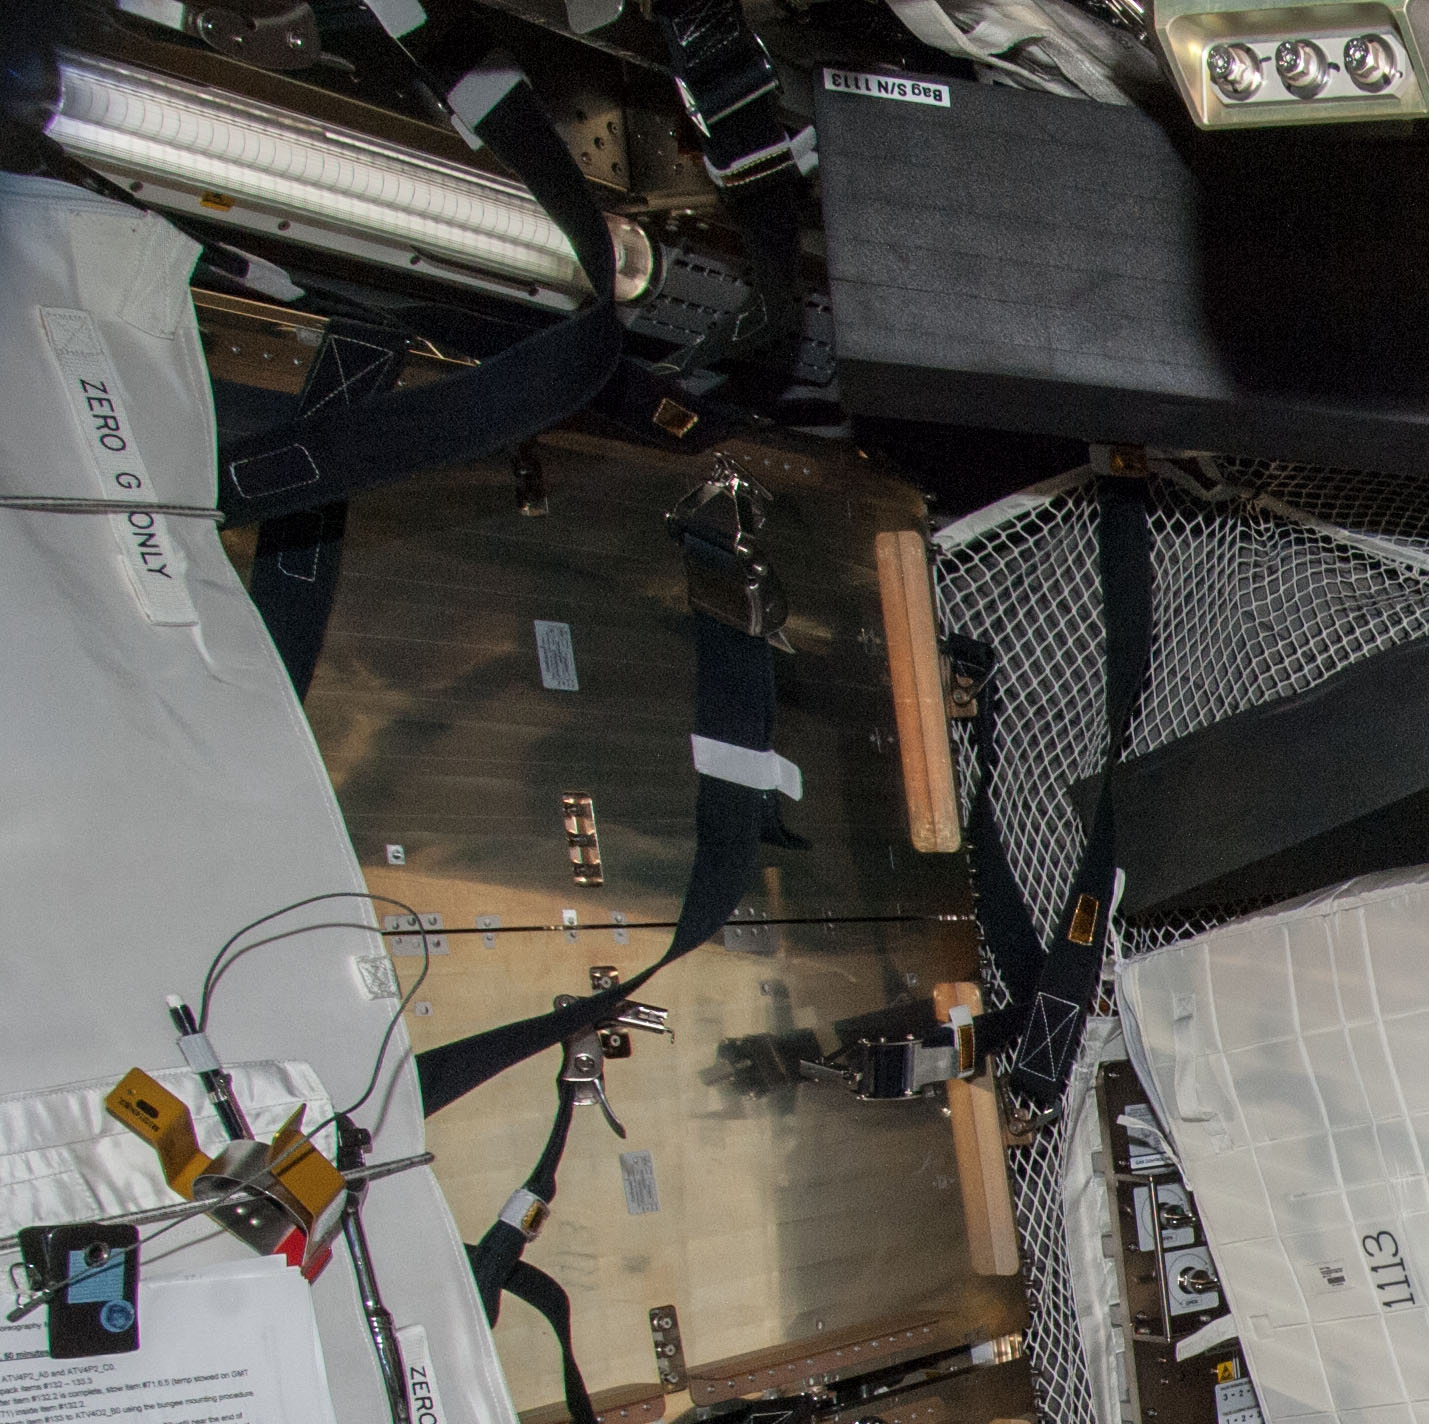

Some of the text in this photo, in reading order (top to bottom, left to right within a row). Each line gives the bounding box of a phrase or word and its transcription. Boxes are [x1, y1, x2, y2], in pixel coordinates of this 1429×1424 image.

[831, 73, 943, 103] Bag S/N 1113
[79, 378, 173, 579] ZERO G ONLY
[1362, 1230, 1416, 1308] 1113
